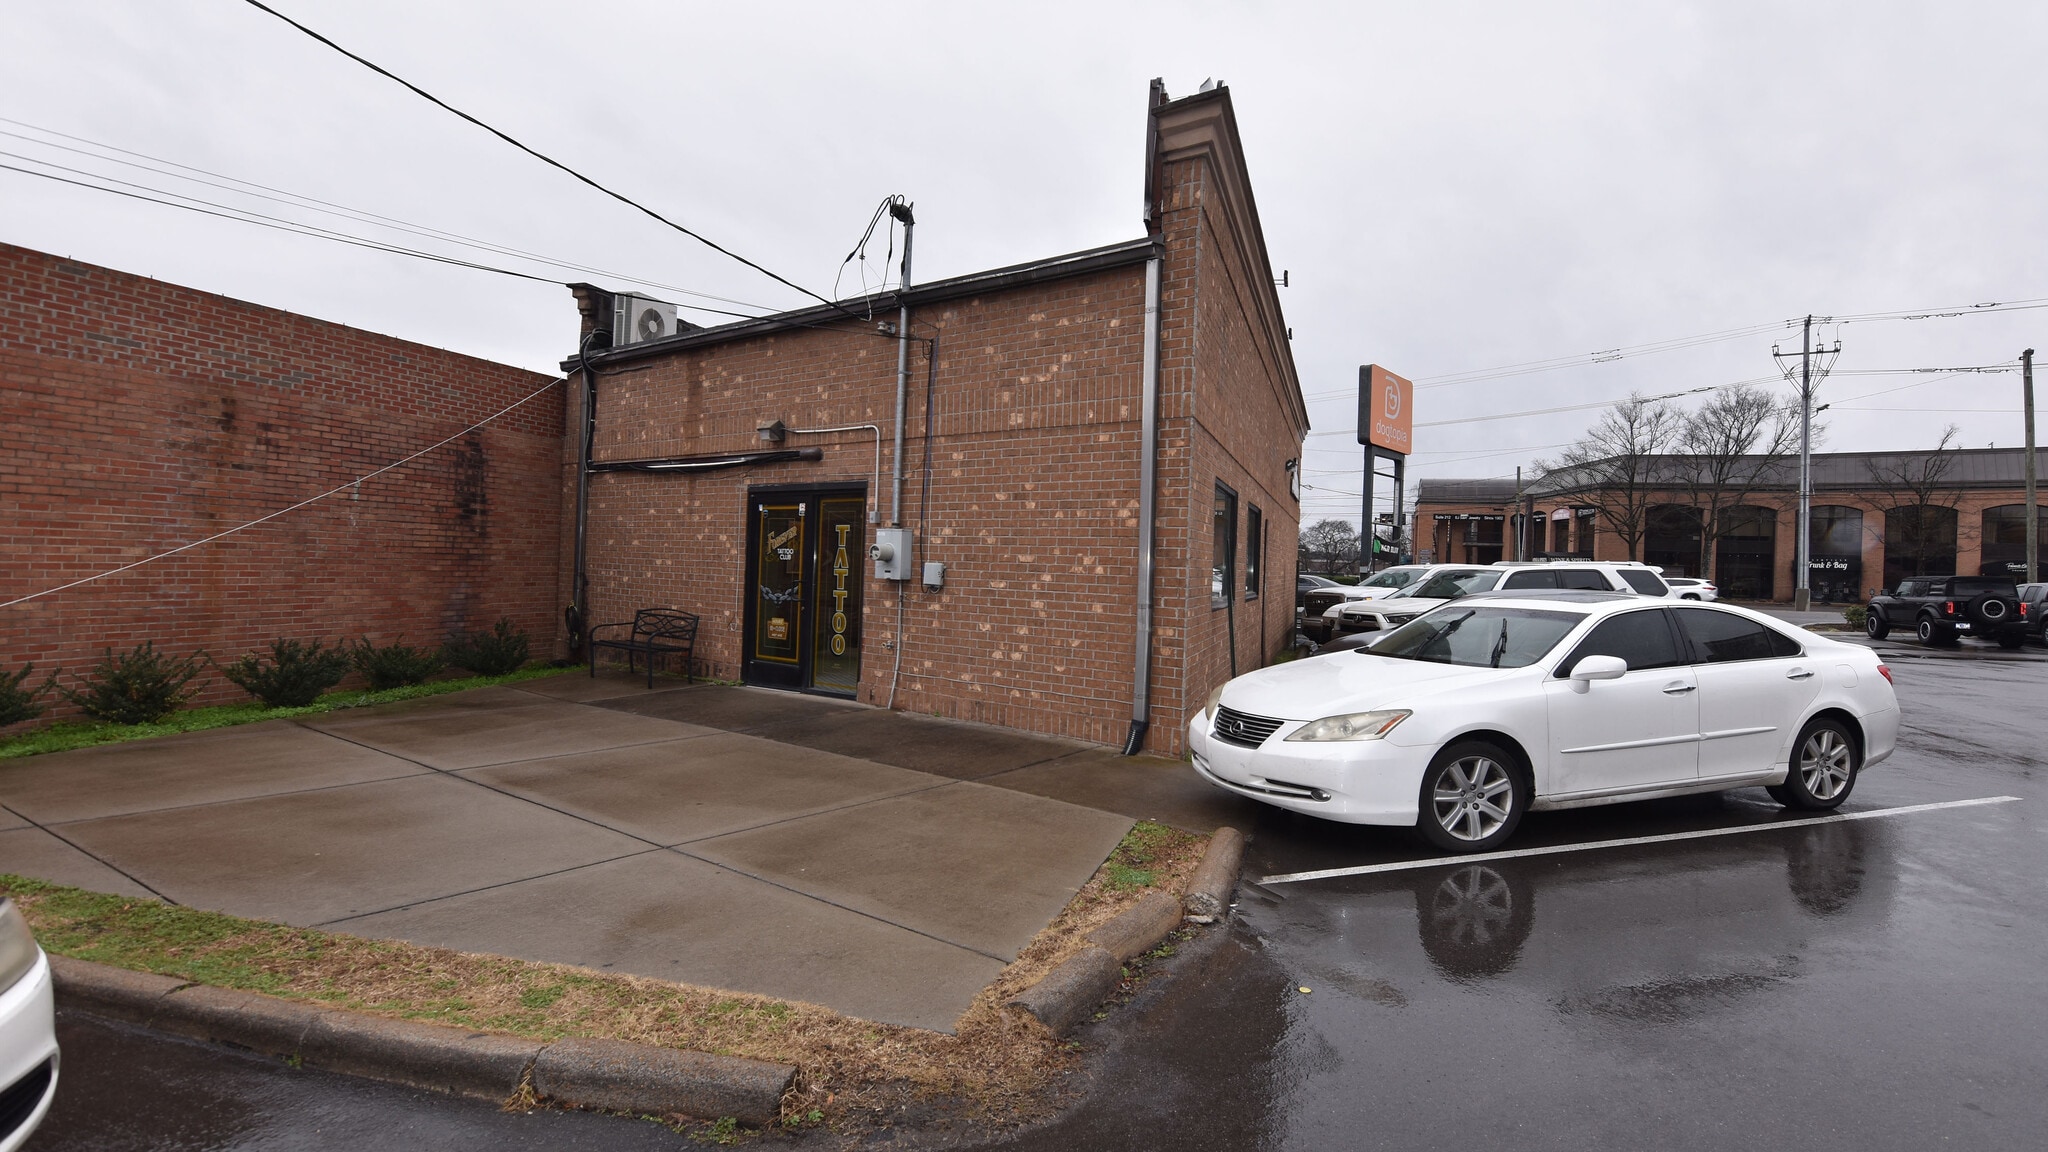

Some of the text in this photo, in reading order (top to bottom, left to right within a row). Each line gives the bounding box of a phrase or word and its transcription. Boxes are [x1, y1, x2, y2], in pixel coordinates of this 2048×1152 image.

[1376, 419, 1407, 443] dogtopia
[1808, 561, 1848, 571] Trunk & Bag
[831, 524, 850, 656] TATTOO
